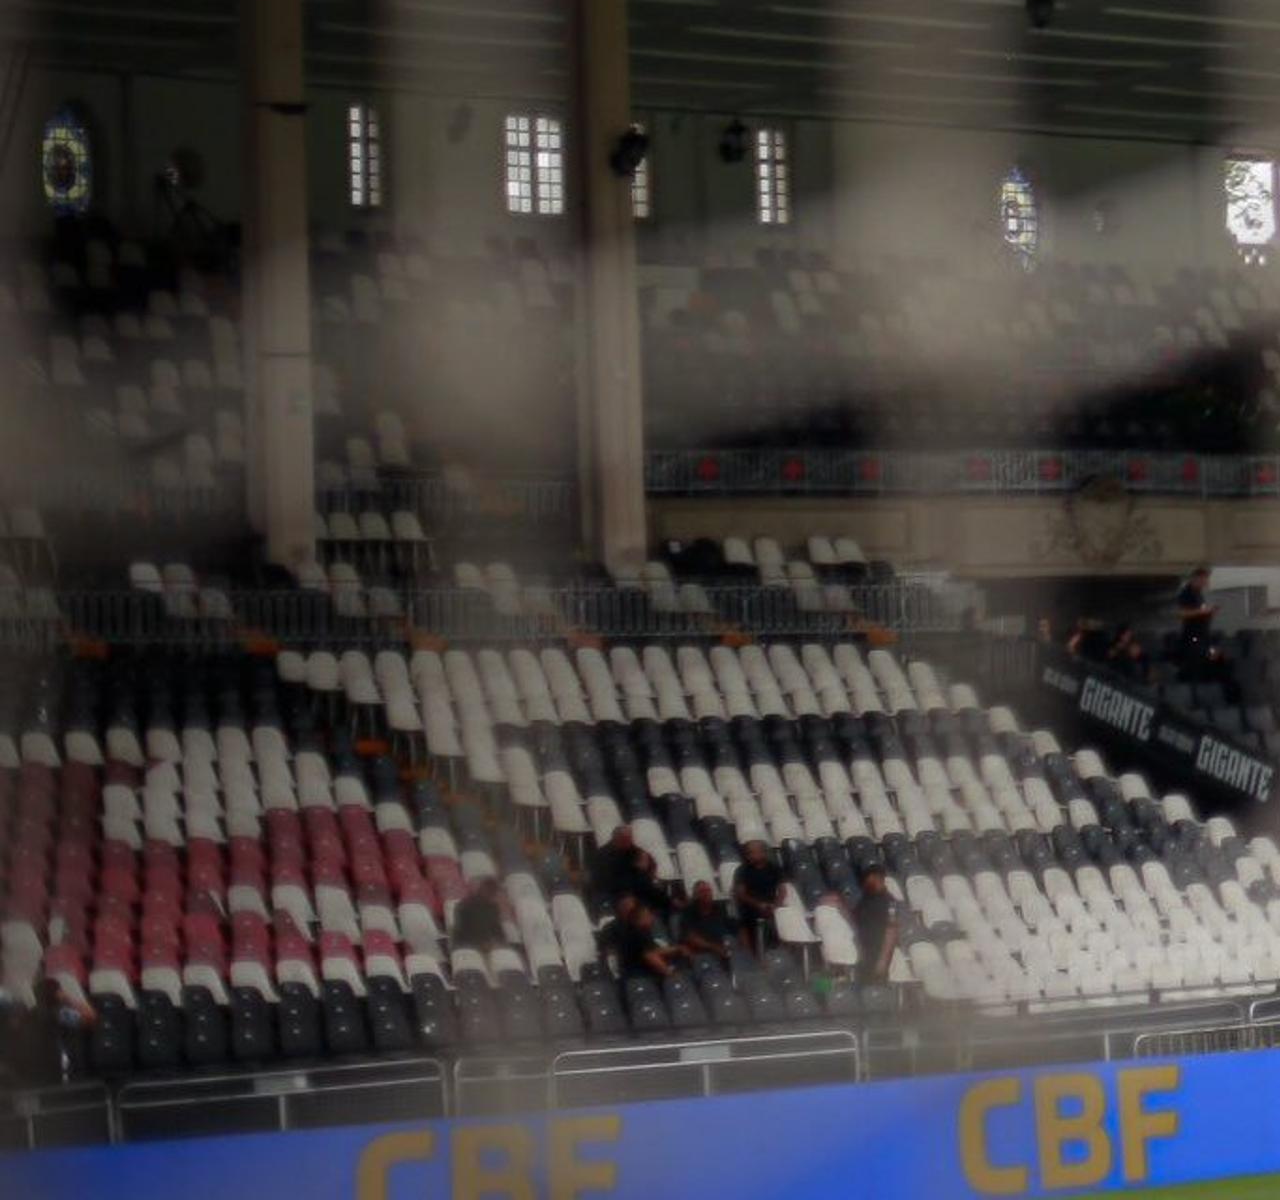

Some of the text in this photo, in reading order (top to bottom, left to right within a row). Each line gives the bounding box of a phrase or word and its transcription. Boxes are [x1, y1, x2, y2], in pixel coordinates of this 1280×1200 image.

[1080, 676, 1154, 742] GIGANTE
[1197, 734, 1275, 803] GIGANTE
[956, 1064, 1182, 1196] CBF
